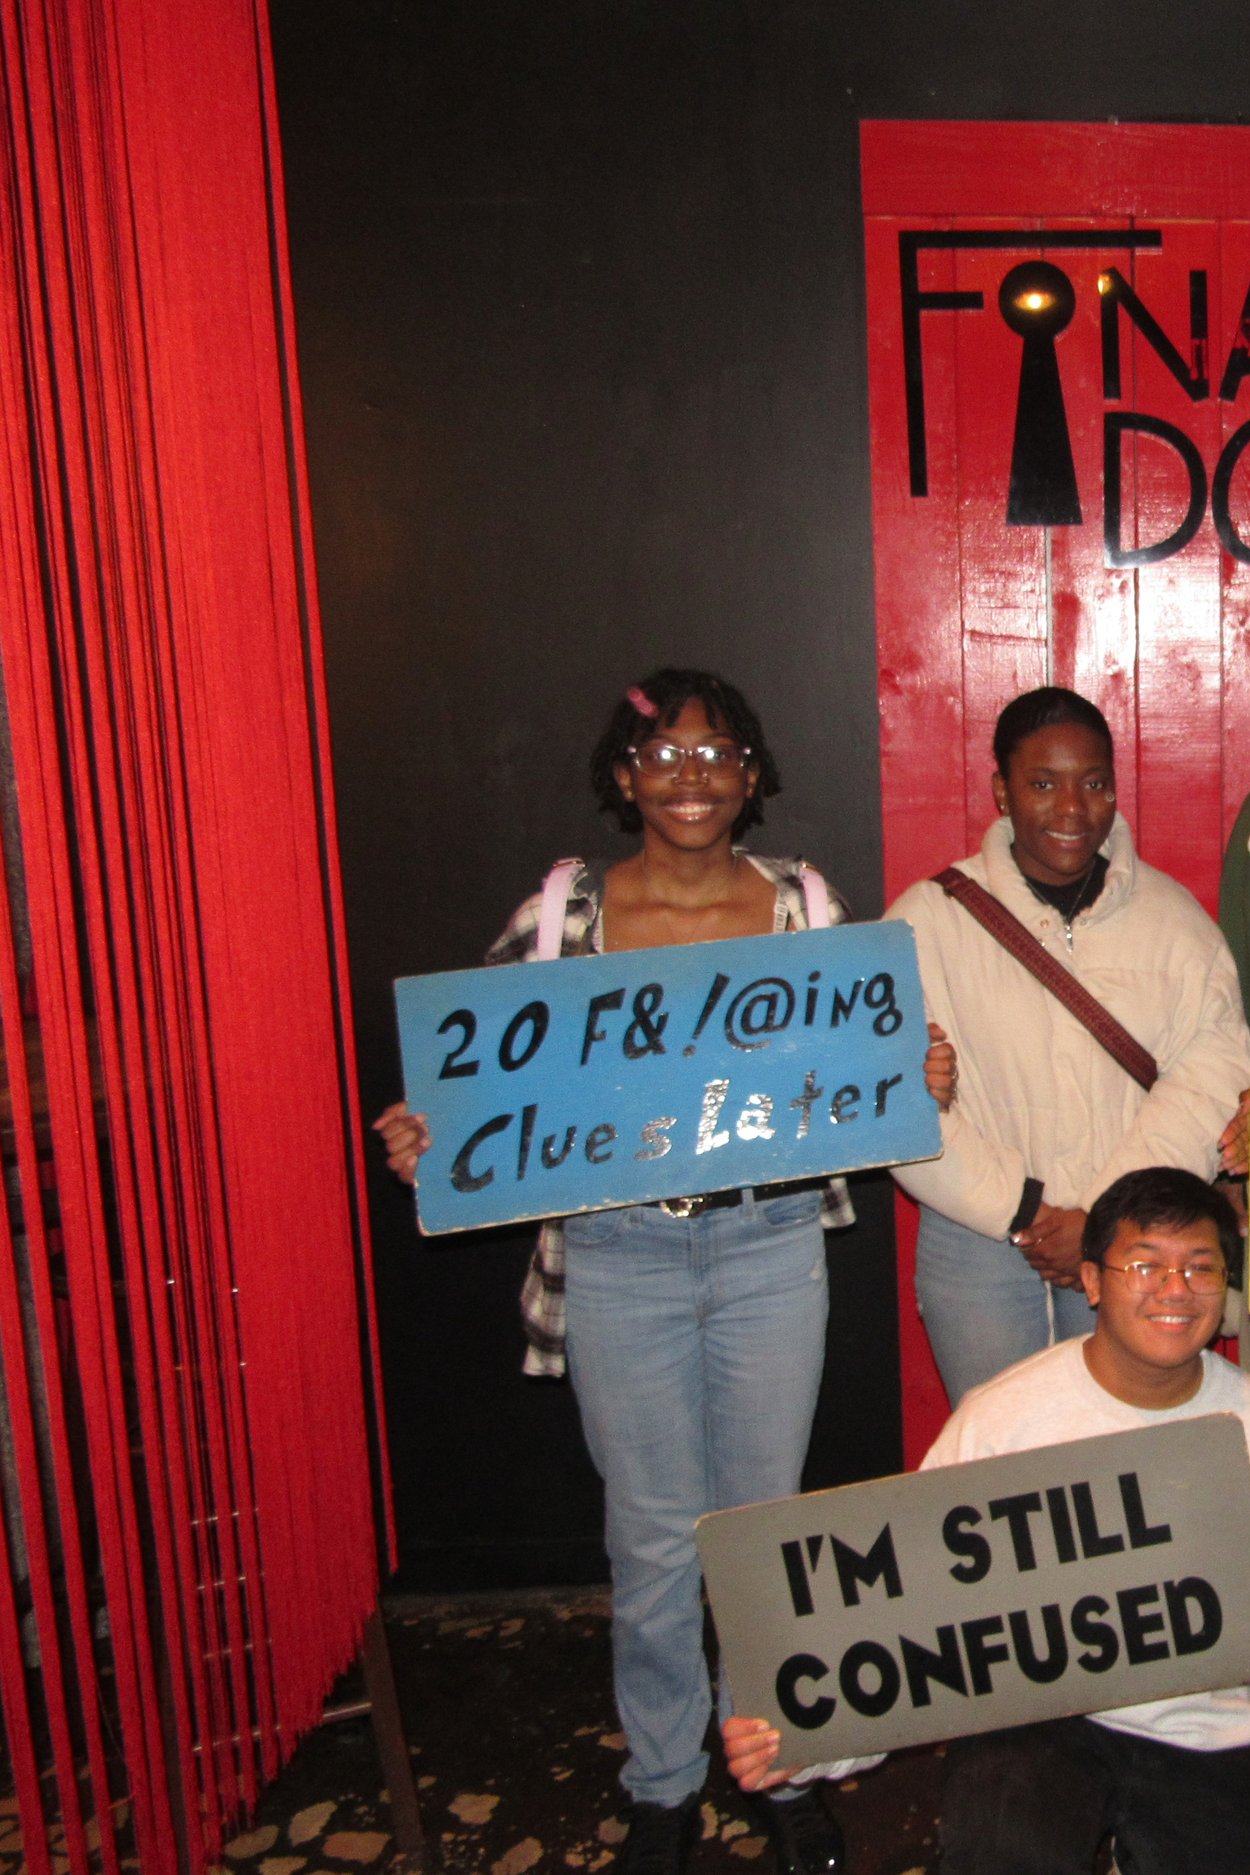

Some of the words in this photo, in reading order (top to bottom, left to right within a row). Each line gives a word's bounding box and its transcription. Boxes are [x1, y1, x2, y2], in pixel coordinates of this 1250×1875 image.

[437, 1000, 550, 1080] 20
[450, 1104, 677, 1193] Clues
[696, 1070, 903, 1156] Later
[780, 1522, 904, 1618] I'M
[942, 1471, 1173, 1585] STILL
[775, 1575, 1223, 1731] CONFUSED
